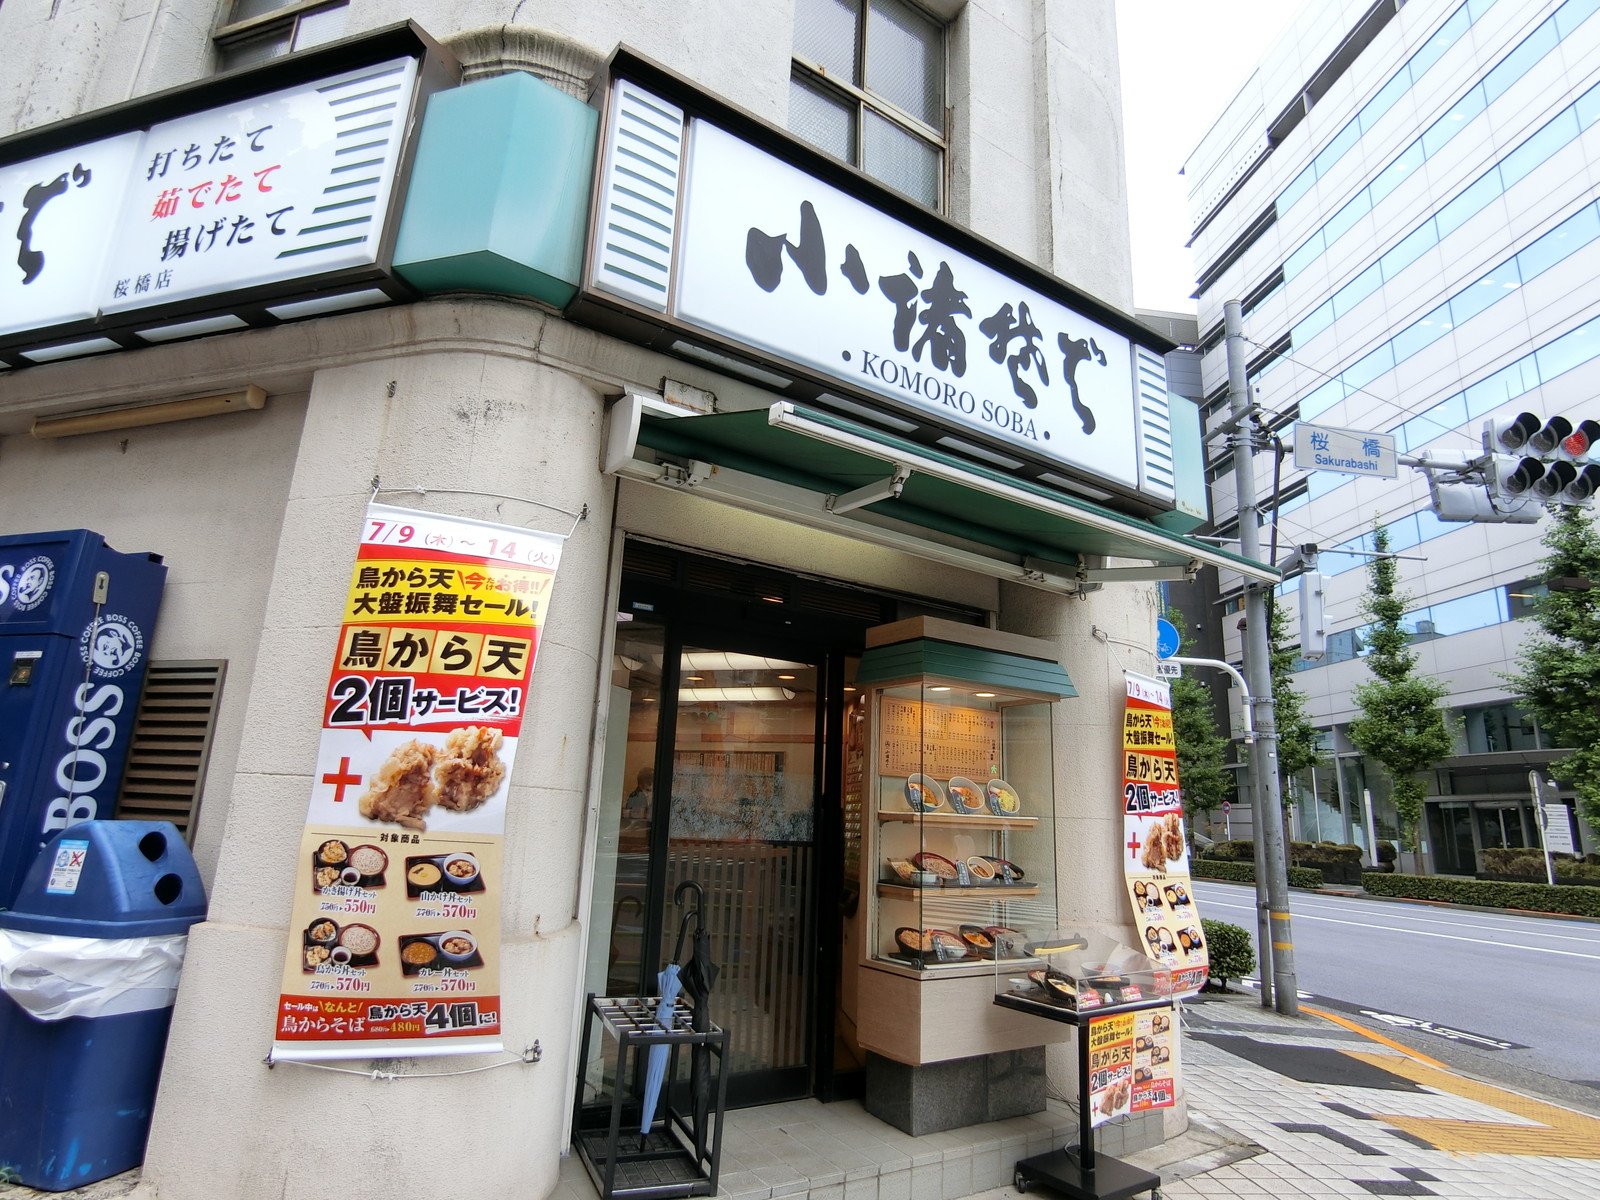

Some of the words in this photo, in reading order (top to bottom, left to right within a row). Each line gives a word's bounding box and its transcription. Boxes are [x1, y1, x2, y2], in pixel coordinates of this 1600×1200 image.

[146, 124, 273, 182] 打ちたて
[150, 164, 281, 224] 茹でたて
[160, 205, 295, 263] 揚げたて
[112, 268, 174, 299] 桜橋店
[861, 350, 976, 414] KOMORO
[981, 399, 1039, 441] SOBA
[1310, 431, 1381, 458] 桜橋
[1314, 453, 1378, 471] Sakurabashi
[356, 566, 455, 590] 鳥から天
[352, 591, 540, 619] 大盤振舞セール!
[106, 613, 128, 624] BOSS
[128, 621, 144, 649] COFFEE
[80, 645, 93, 666] OSS
[125, 651, 142, 672] BOSS
[342, 630, 527, 676] 鳥から天
[93, 666, 125, 678] COFFEE
[330, 677, 519, 723] 2個サービス!
[1126, 712, 1152, 729] 鳥から天
[42, 682, 124, 834] BOSS
[1126, 754, 1176, 786] 鳥から天
[380, 833, 420, 844] 対象商品
[344, 899, 376, 914] 550円
[442, 905, 476, 918] 570円
[336, 977, 370, 991] 570円
[441, 979, 476, 991] 570円
[325, 1001, 357, 1013] なんと
[281, 1015, 366, 1033] 鳥からそば
[390, 1022, 420, 1032] 480円
[1091, 1046, 1131, 1068] 鳥から天
